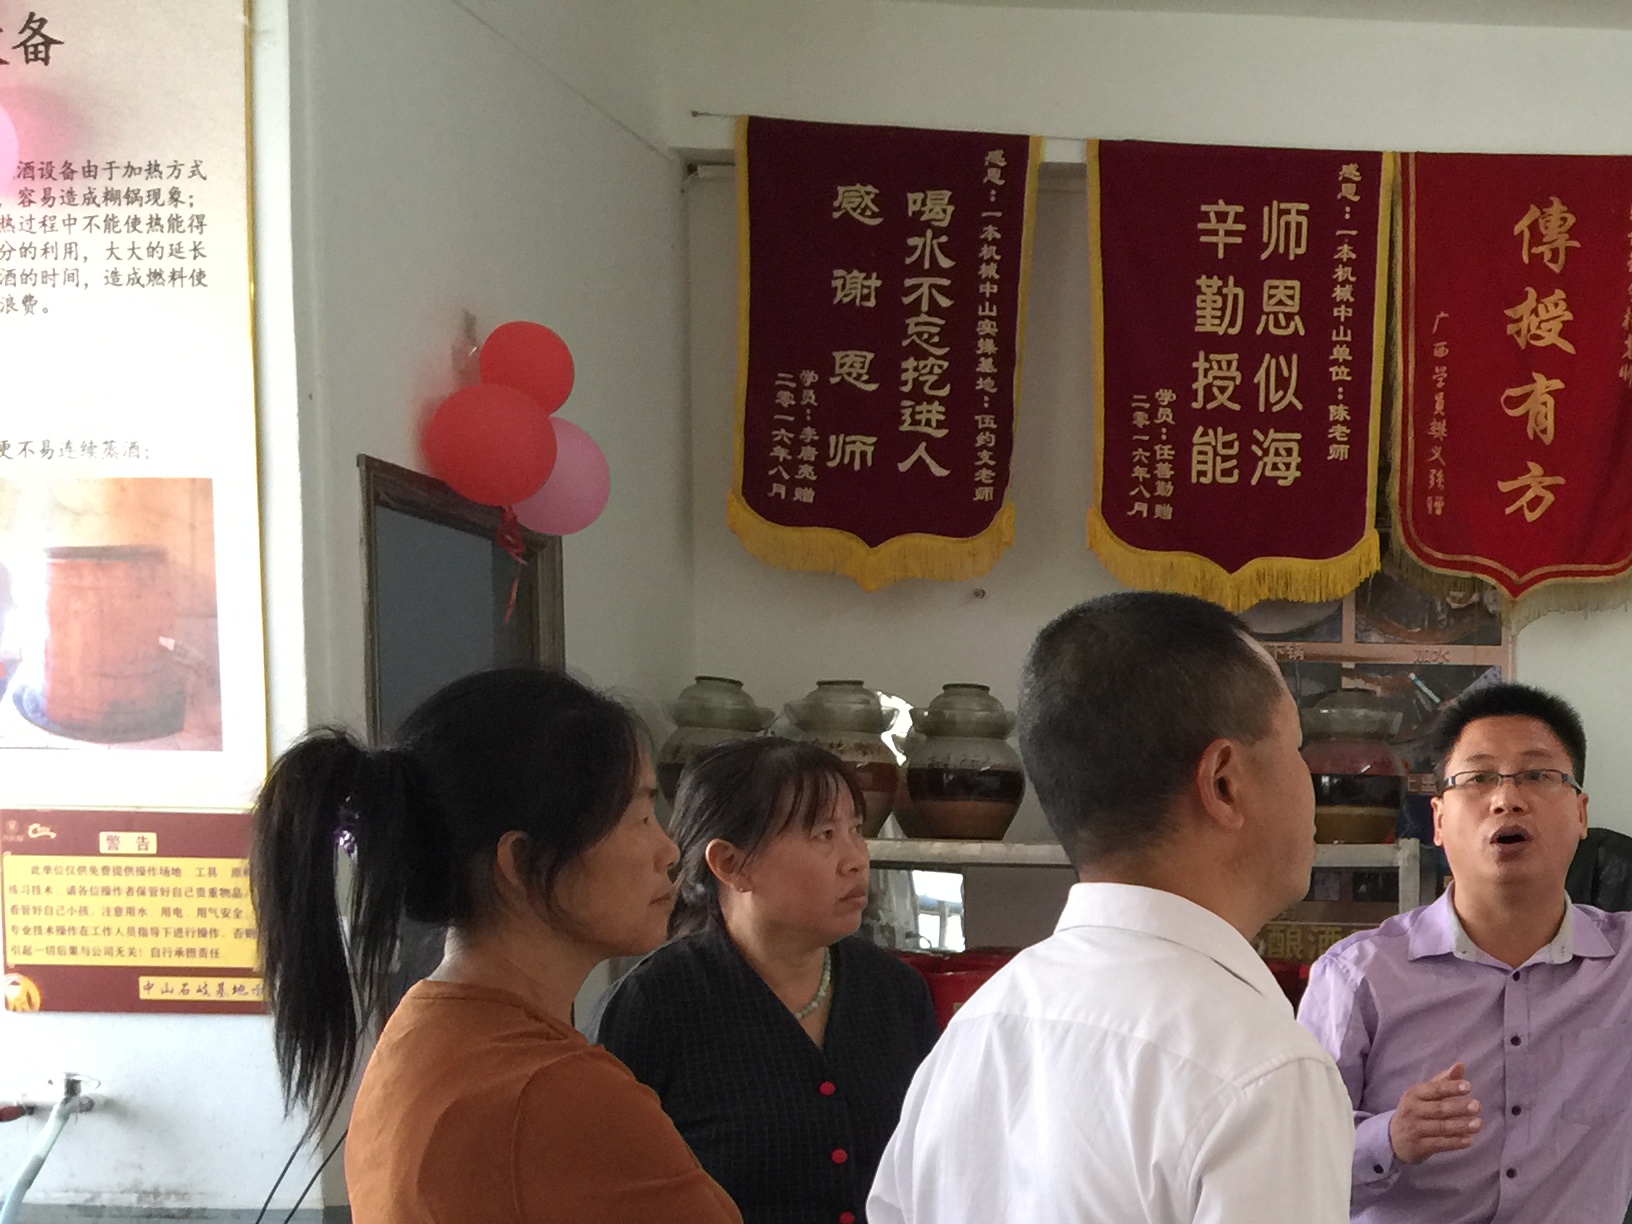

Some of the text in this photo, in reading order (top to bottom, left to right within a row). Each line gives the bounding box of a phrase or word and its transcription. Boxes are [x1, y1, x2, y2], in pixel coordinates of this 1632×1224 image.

[0, 11, 64, 67] 备
[826, 183, 884, 471] 感谢恩师
[1190, 199, 1246, 485] 辛勤授能
[1250, 200, 1310, 487] 师恩似海
